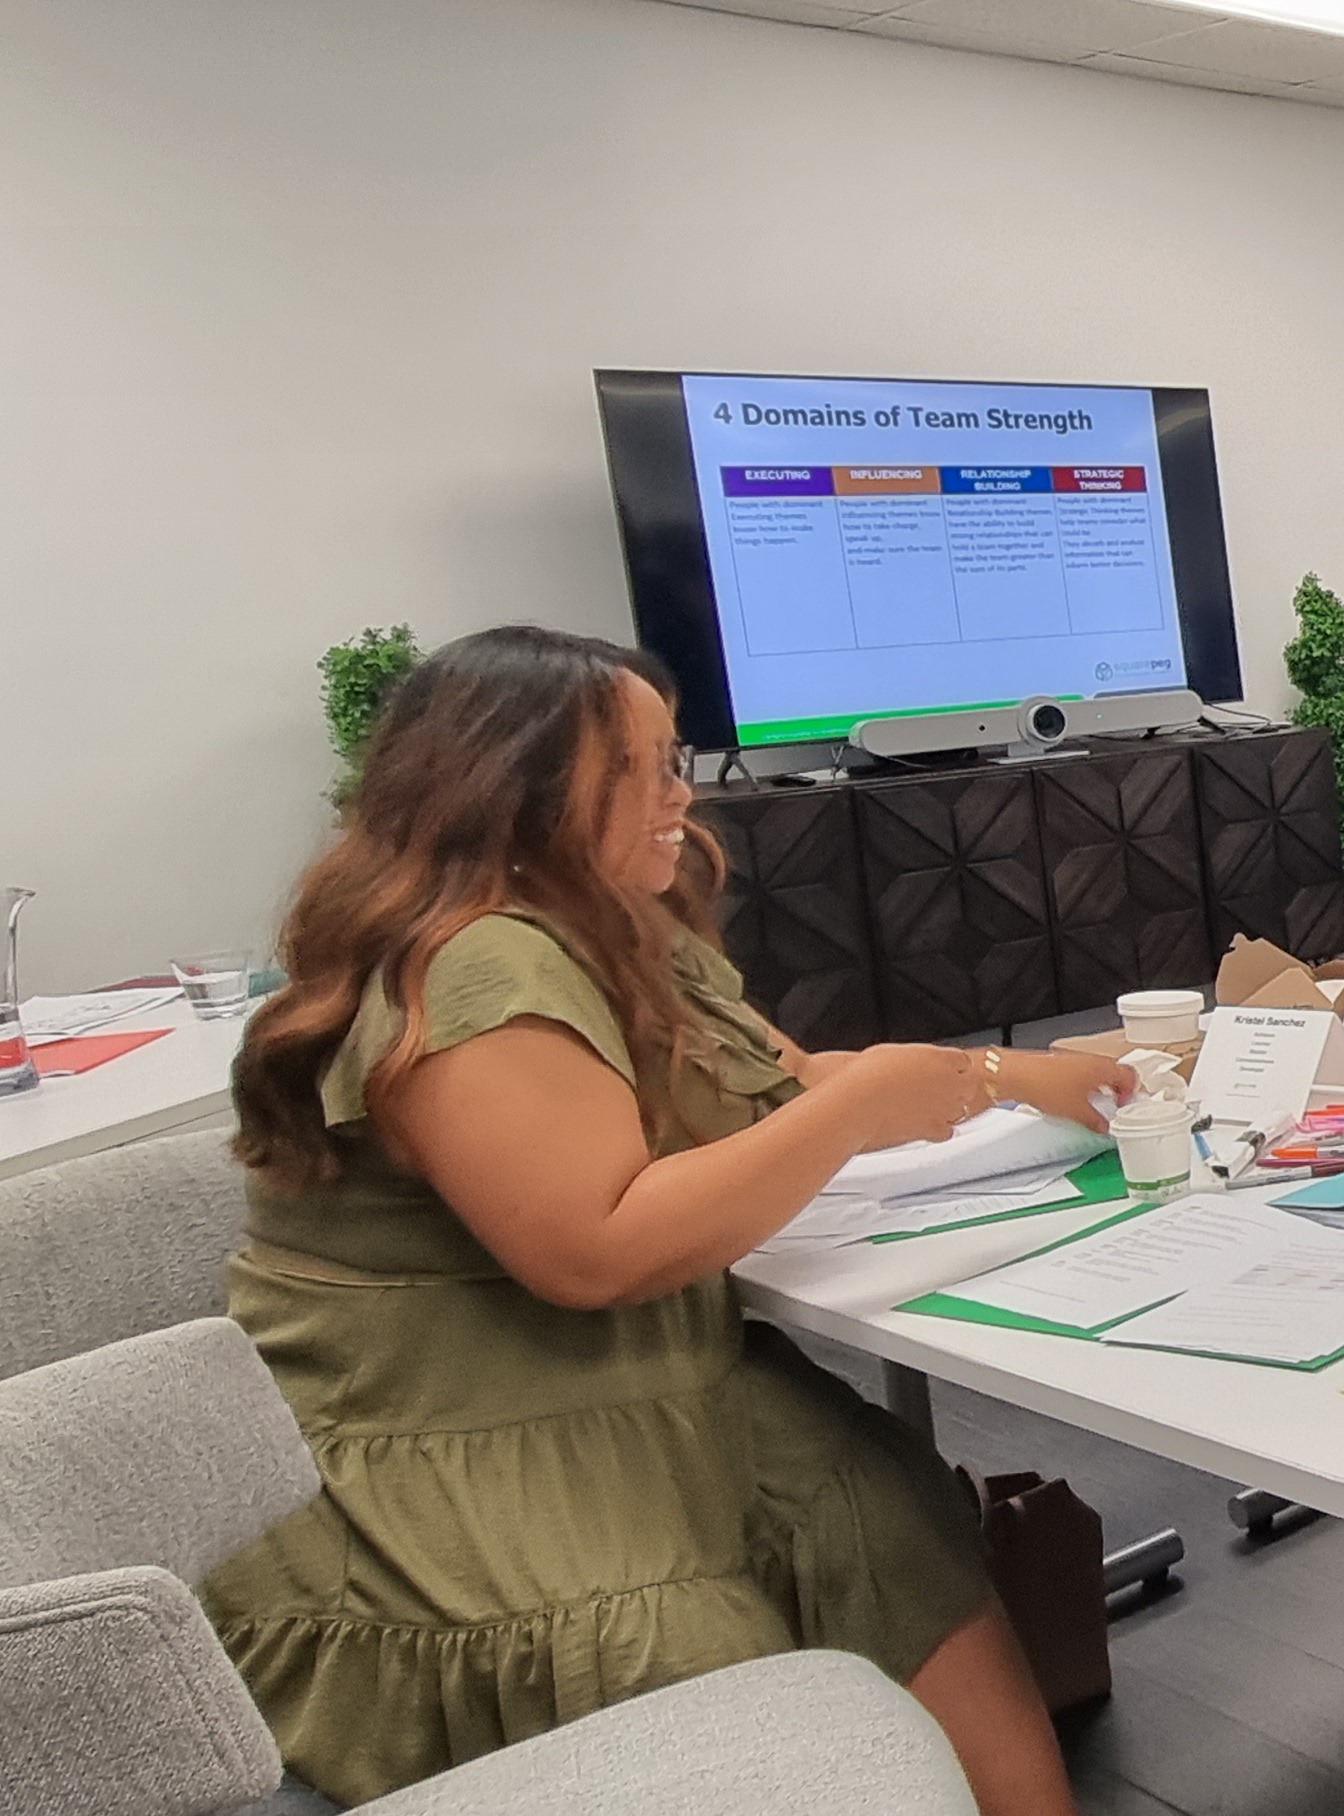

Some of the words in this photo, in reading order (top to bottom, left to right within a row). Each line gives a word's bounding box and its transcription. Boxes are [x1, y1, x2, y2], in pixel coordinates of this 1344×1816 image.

[713, 403, 732, 425] 4
[742, 403, 867, 427] Domains
[874, 404, 901, 428] of
[906, 406, 980, 429] Team
[986, 408, 1094, 435] Strength
[745, 470, 811, 480] EXECUTING
[850, 470, 923, 480] INFLUENCING
[961, 470, 1032, 479] RELATIONSHIP
[1073, 470, 1125, 479] STRATEGIC
[974, 481, 1021, 491] BUILDING
[1266, 1016, 1306, 1028] Sanchez
